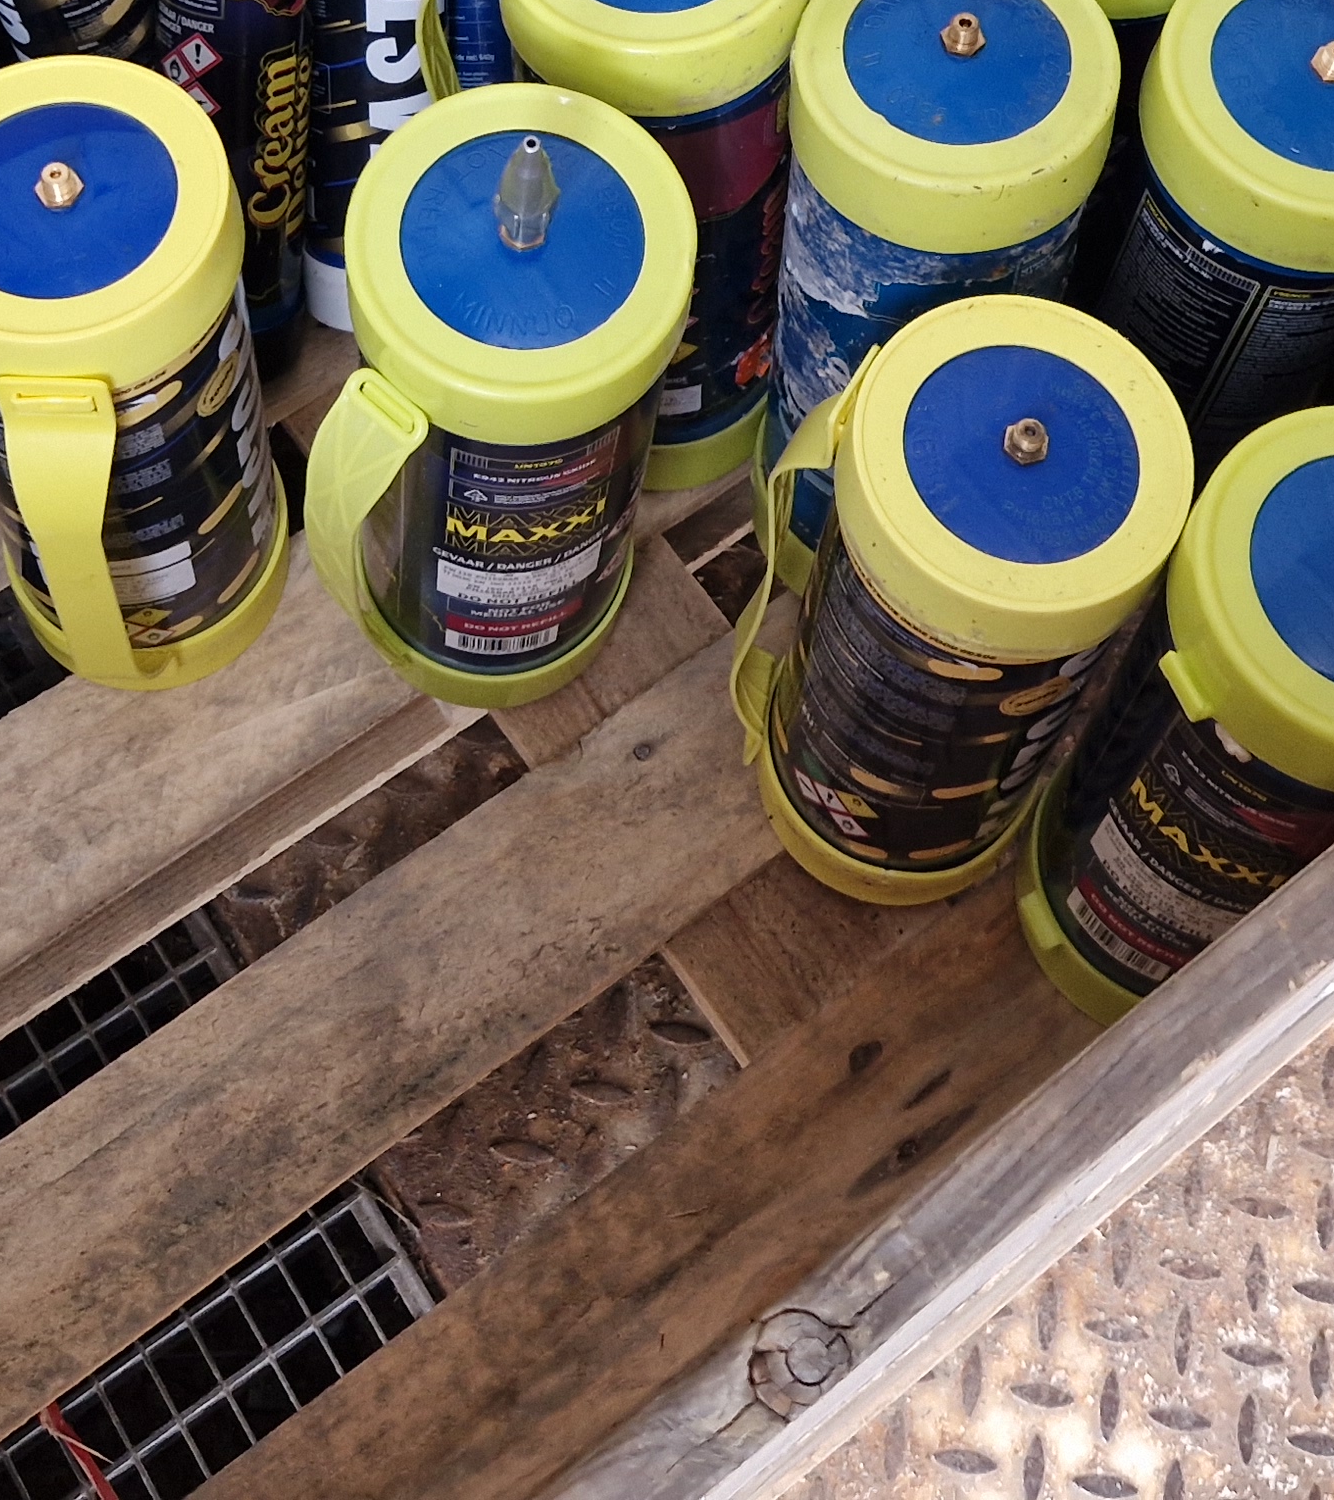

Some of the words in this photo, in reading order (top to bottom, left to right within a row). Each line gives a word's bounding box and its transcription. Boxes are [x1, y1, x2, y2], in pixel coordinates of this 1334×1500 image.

[180, 15, 215, 34] DANGER
[248, 52, 298, 227] Cream
[446, 495, 607, 544] MAXXI
[432, 545, 485, 571] GEVAAR
[496, 557, 554, 572] DANGER
[1129, 776, 1290, 889] MAXXI
[1148, 856, 1203, 897] DANGER
